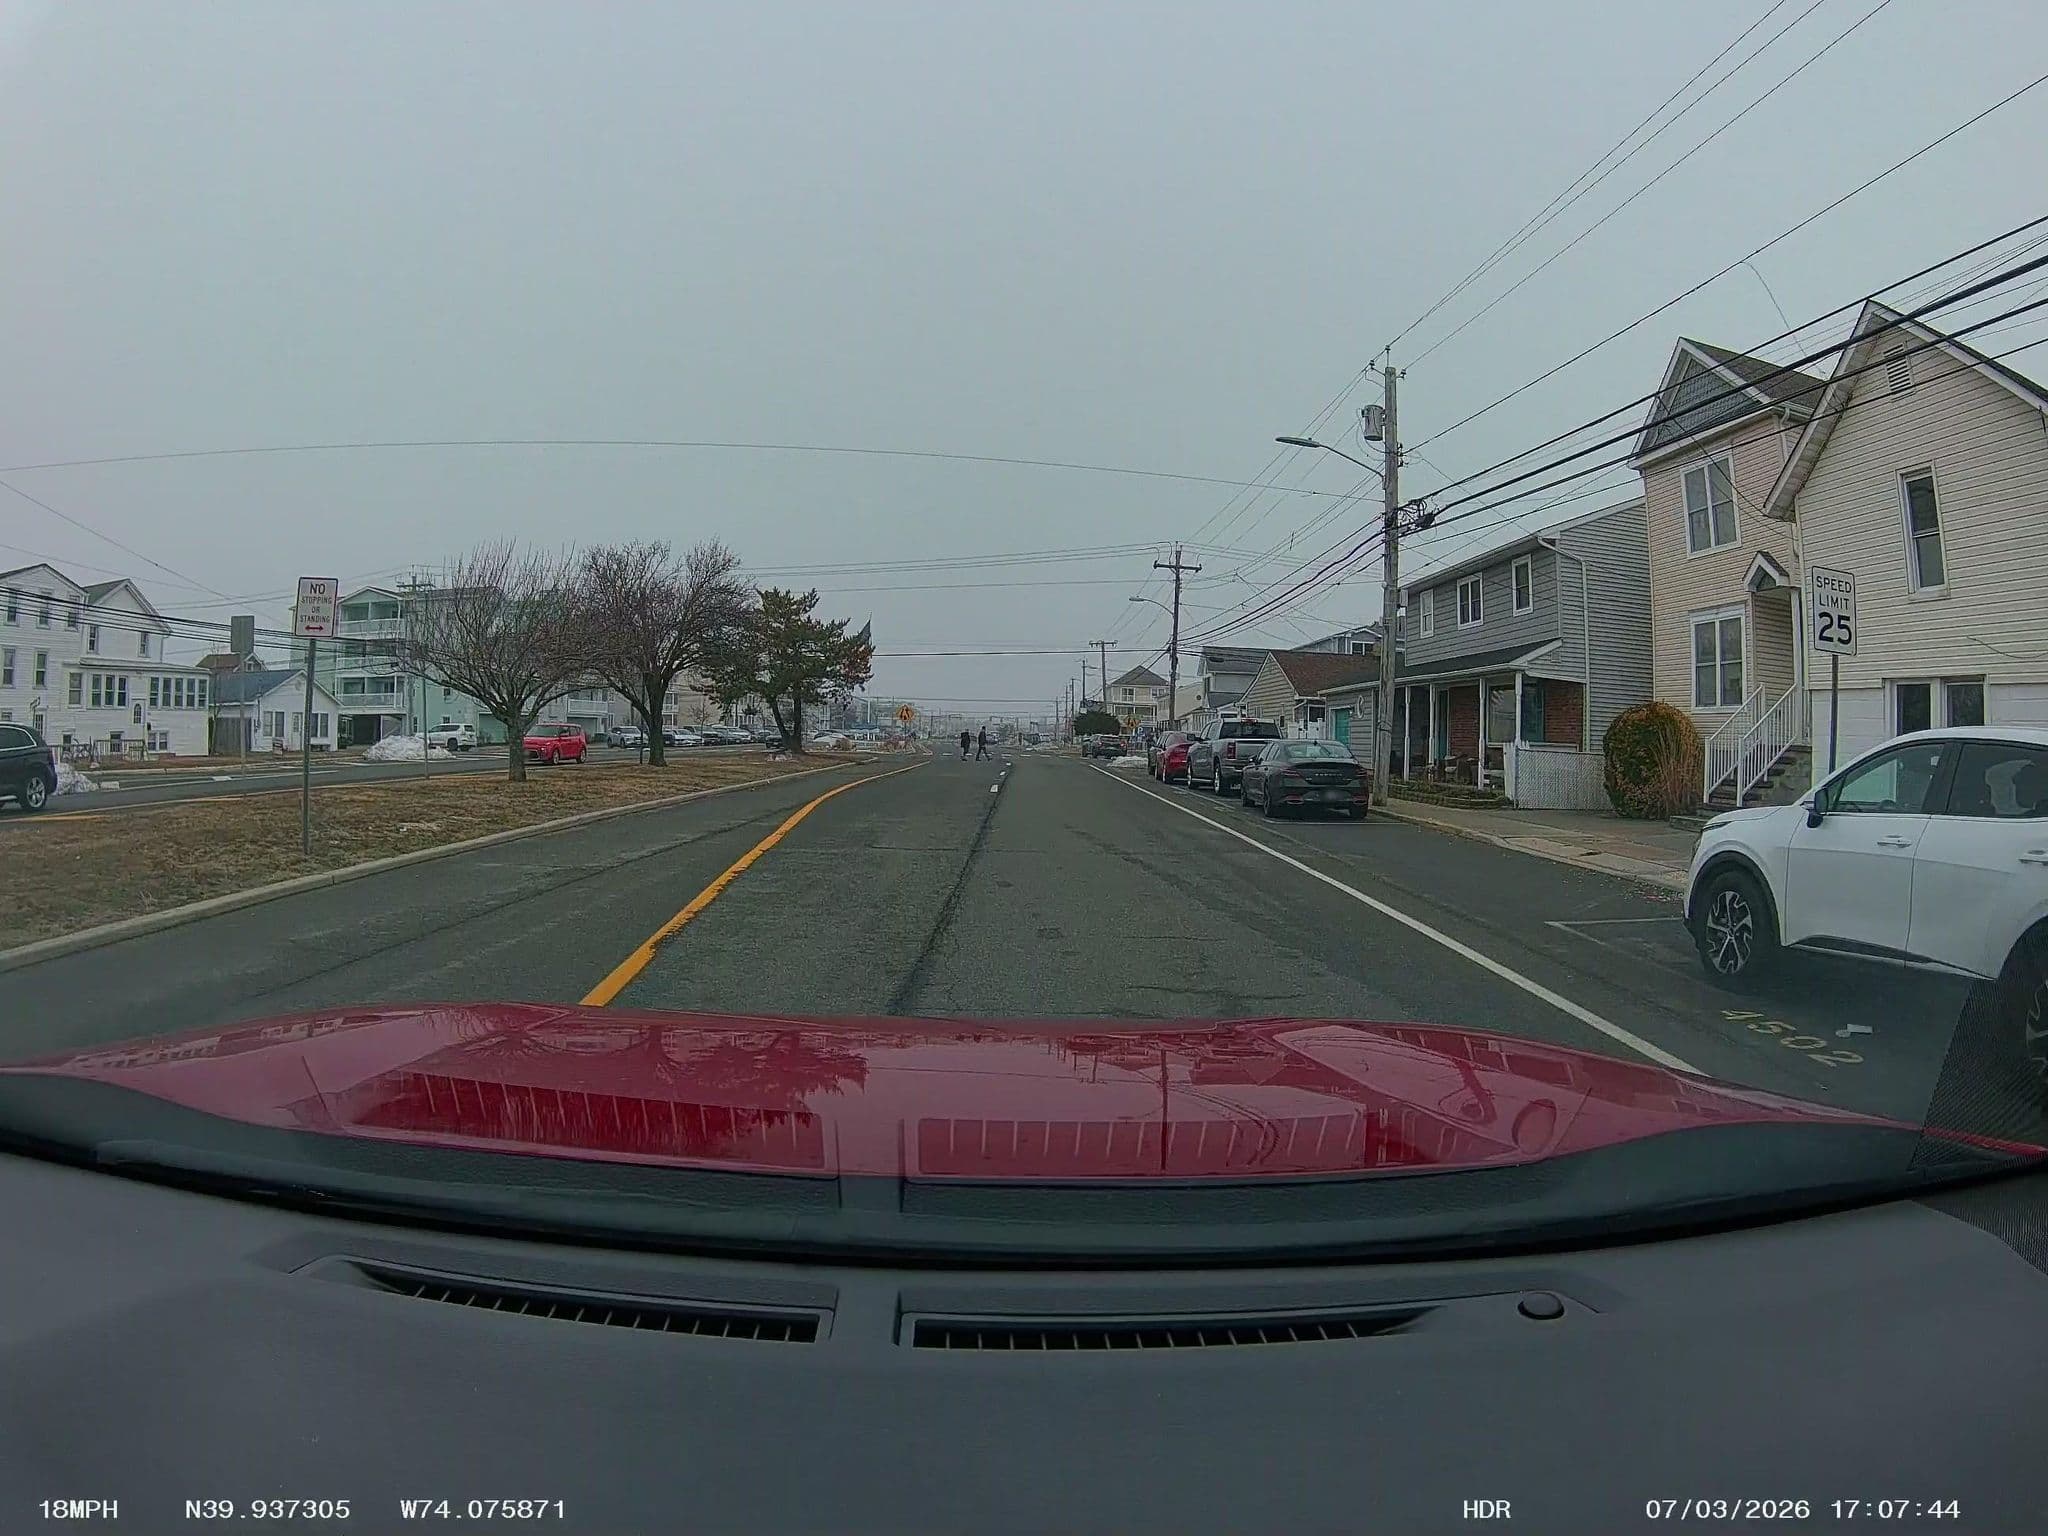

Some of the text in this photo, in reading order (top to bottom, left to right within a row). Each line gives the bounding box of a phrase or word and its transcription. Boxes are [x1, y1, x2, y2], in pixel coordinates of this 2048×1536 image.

[309, 582, 326, 595] NO
[1816, 575, 1852, 594] SPEED
[301, 596, 332, 605] STOPPING
[1819, 593, 1850, 611] LIMIT
[311, 606, 321, 614] OR
[299, 614, 331, 624] STANDING
[1818, 611, 1852, 645] 25
[1720, 1009, 1864, 1068] 4502
